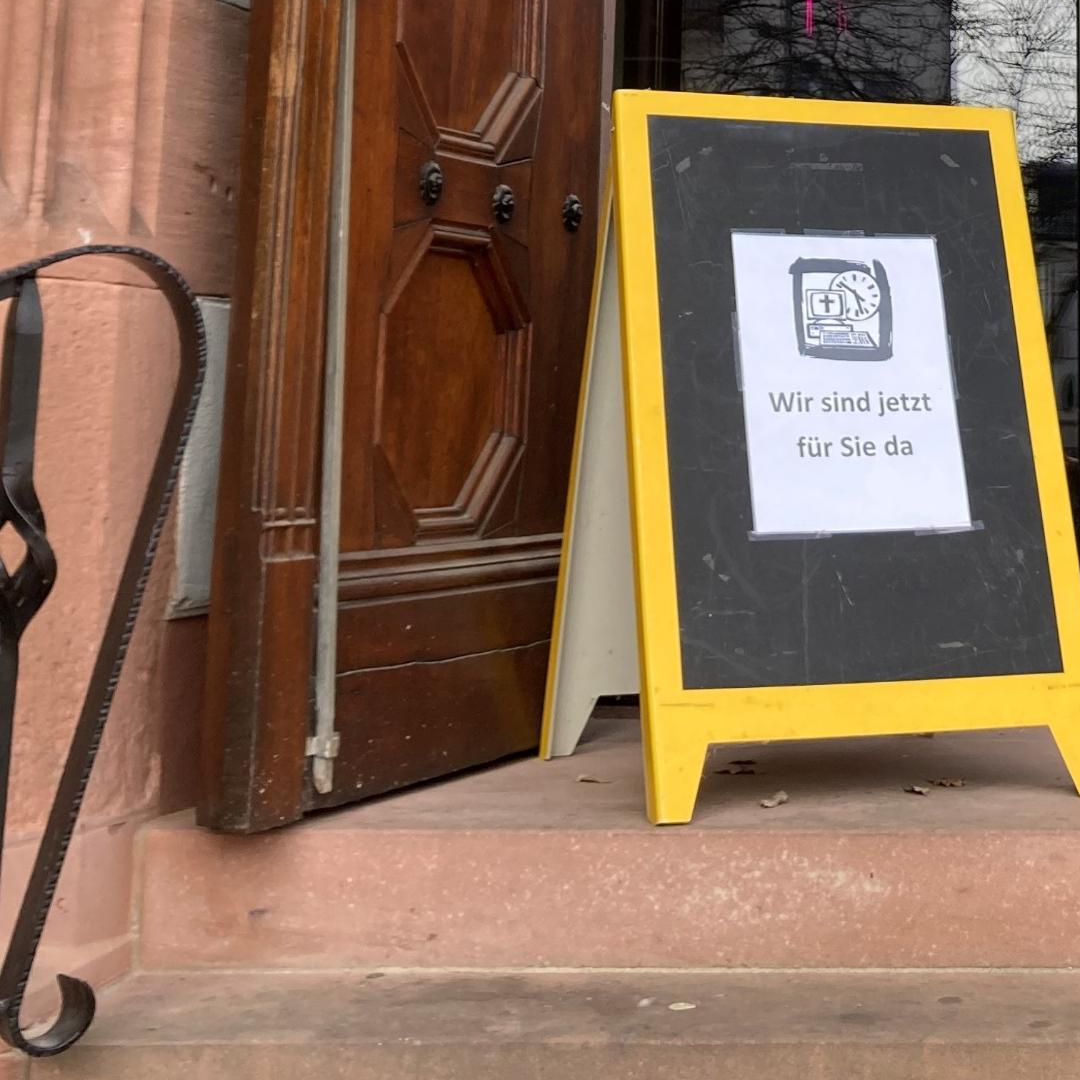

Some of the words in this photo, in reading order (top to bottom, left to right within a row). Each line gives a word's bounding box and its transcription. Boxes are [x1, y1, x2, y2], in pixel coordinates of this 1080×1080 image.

[769, 391, 814, 413] Wir
[821, 391, 871, 412] sind
[878, 391, 932, 417] jetzt
[796, 436, 833, 458] für
[840, 435, 876, 457] Sie
[884, 434, 914, 456] da
